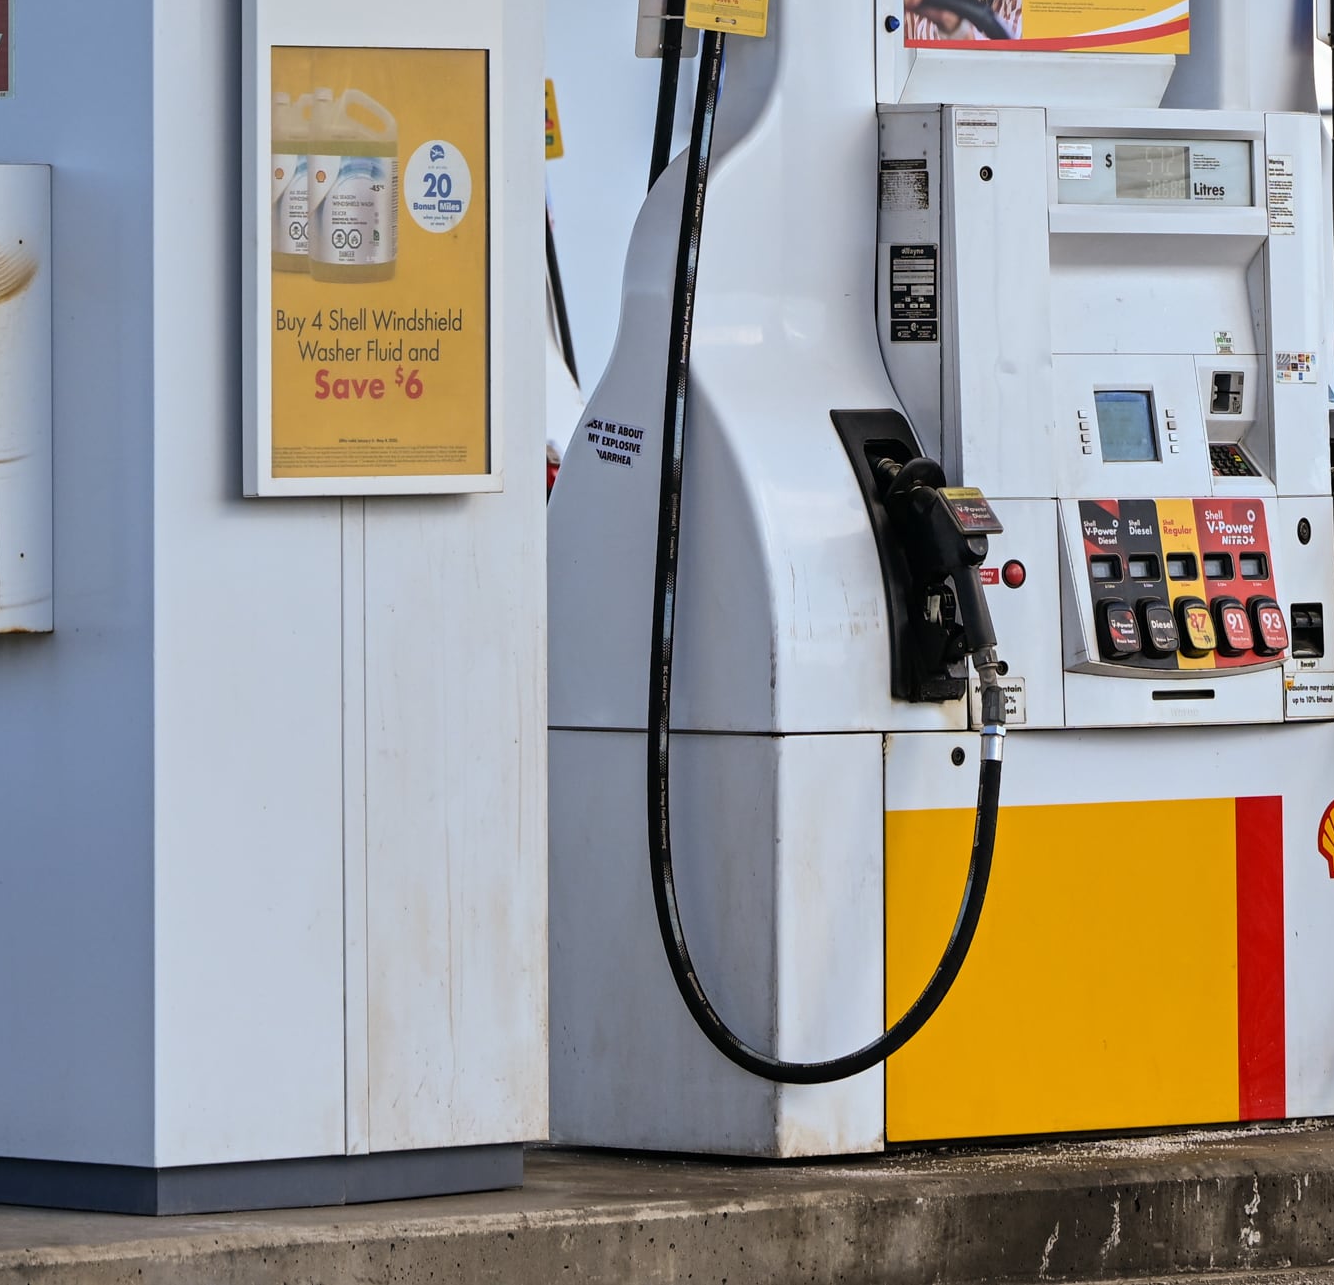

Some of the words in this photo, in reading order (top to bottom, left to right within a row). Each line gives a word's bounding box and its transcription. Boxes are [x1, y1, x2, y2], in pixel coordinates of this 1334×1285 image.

[1105, 153, 1113, 169] $
[423, 173, 452, 198] 20
[1194, 183, 1225, 196] Litres
[413, 202, 436, 211] Bonus
[439, 203, 460, 211] Miles
[276, 310, 306, 337] Buy
[311, 310, 323, 331] 4
[329, 308, 367, 331] Shell
[372, 308, 462, 331] Windshield
[298, 339, 361, 361] Washer
[367, 339, 403, 361] Fluid
[408, 339, 440, 361] and
[315, 369, 385, 399] Save
[394, 365, 423, 399] $6
[605, 422, 616, 433] ME
[618, 426, 643, 440] ABOUT
[588, 432, 600, 443] MY
[602, 436, 641, 453] EXPLOSIVE
[596, 449, 631, 466] IARRHEA
[1205, 509, 1223, 520] Shell
[1085, 527, 1117, 536] V-Power
[1129, 525, 1153, 535] Diesel
[1163, 525, 1193, 537] Regular
[1098, 536, 1118, 545] Diesel
[1151, 619, 1174, 628] Diesel
[1190, 613, 1207, 629] 87
[1227, 612, 1244, 630] 91
[1262, 612, 1282, 630] 93
